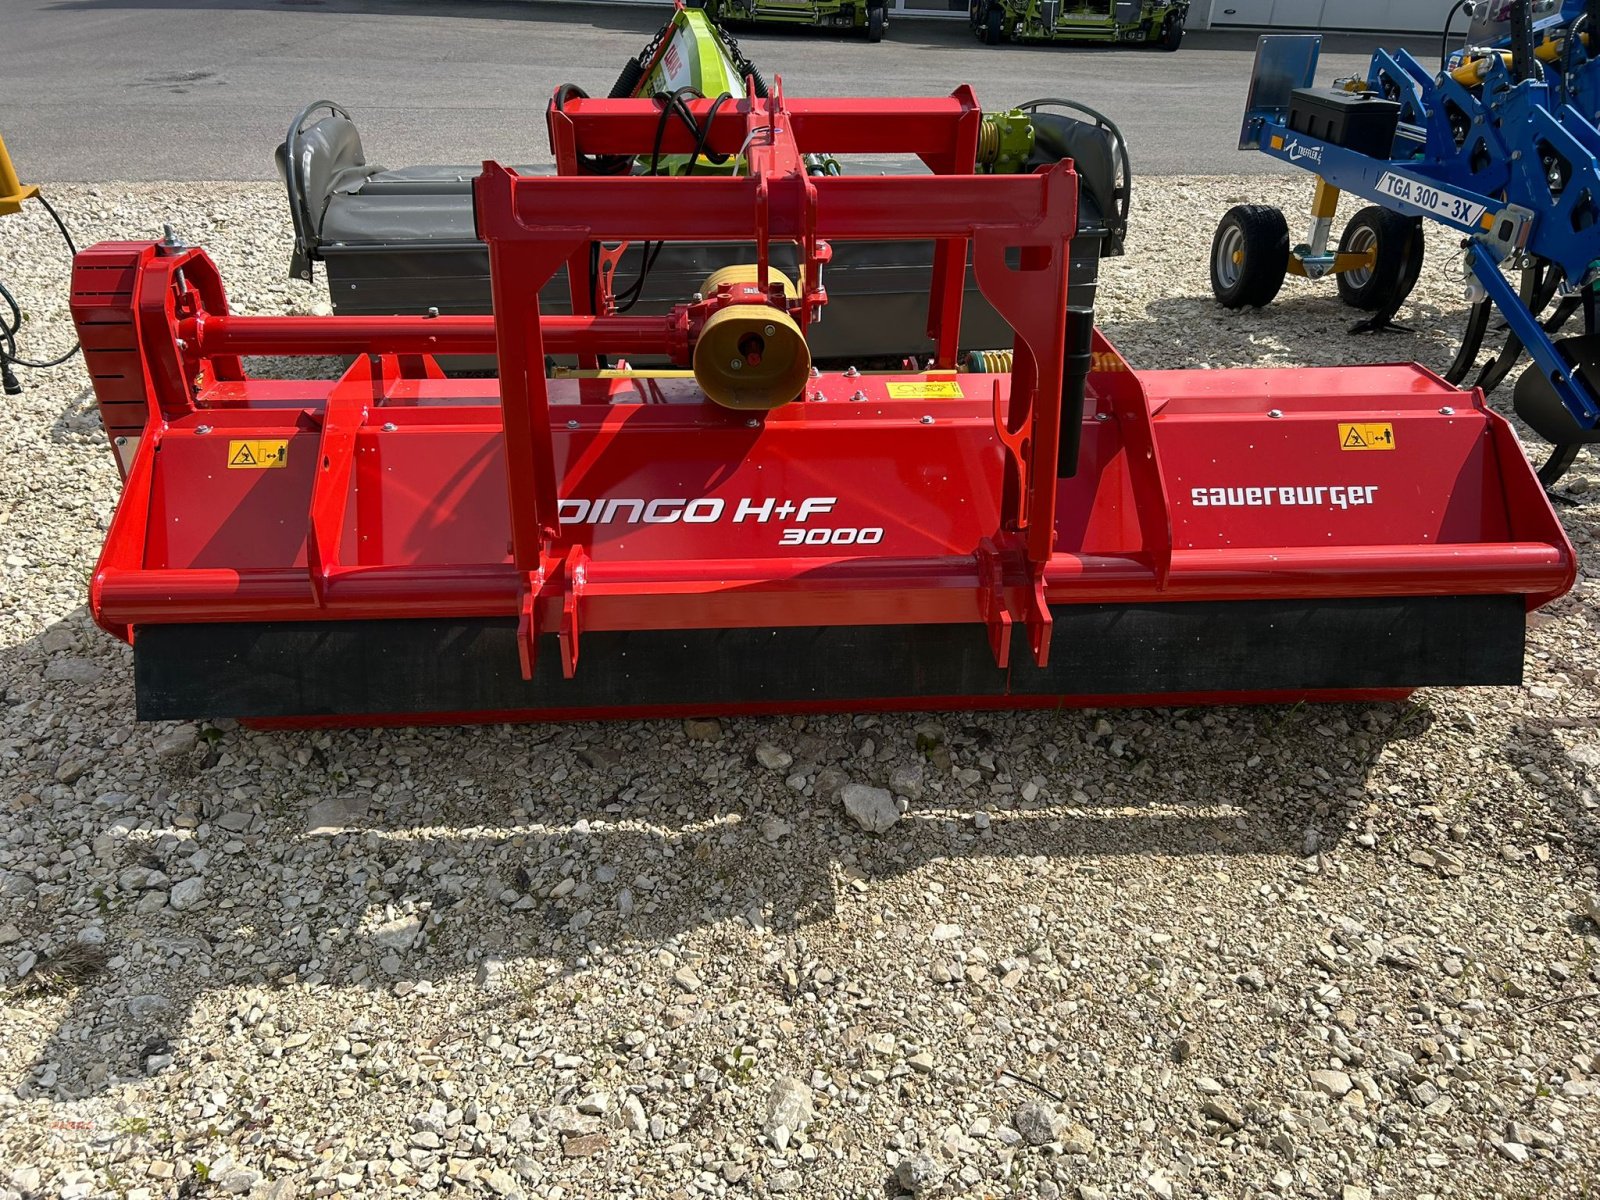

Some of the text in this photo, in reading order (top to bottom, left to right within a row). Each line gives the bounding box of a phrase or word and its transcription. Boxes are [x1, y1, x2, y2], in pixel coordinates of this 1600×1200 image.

[1387, 174, 1411, 200] TGA
[1414, 186, 1438, 210] 300
[1451, 199, 1472, 222] 3X
[557, 496, 837, 524] DINGO H+F
[778, 527, 884, 546] 3000
